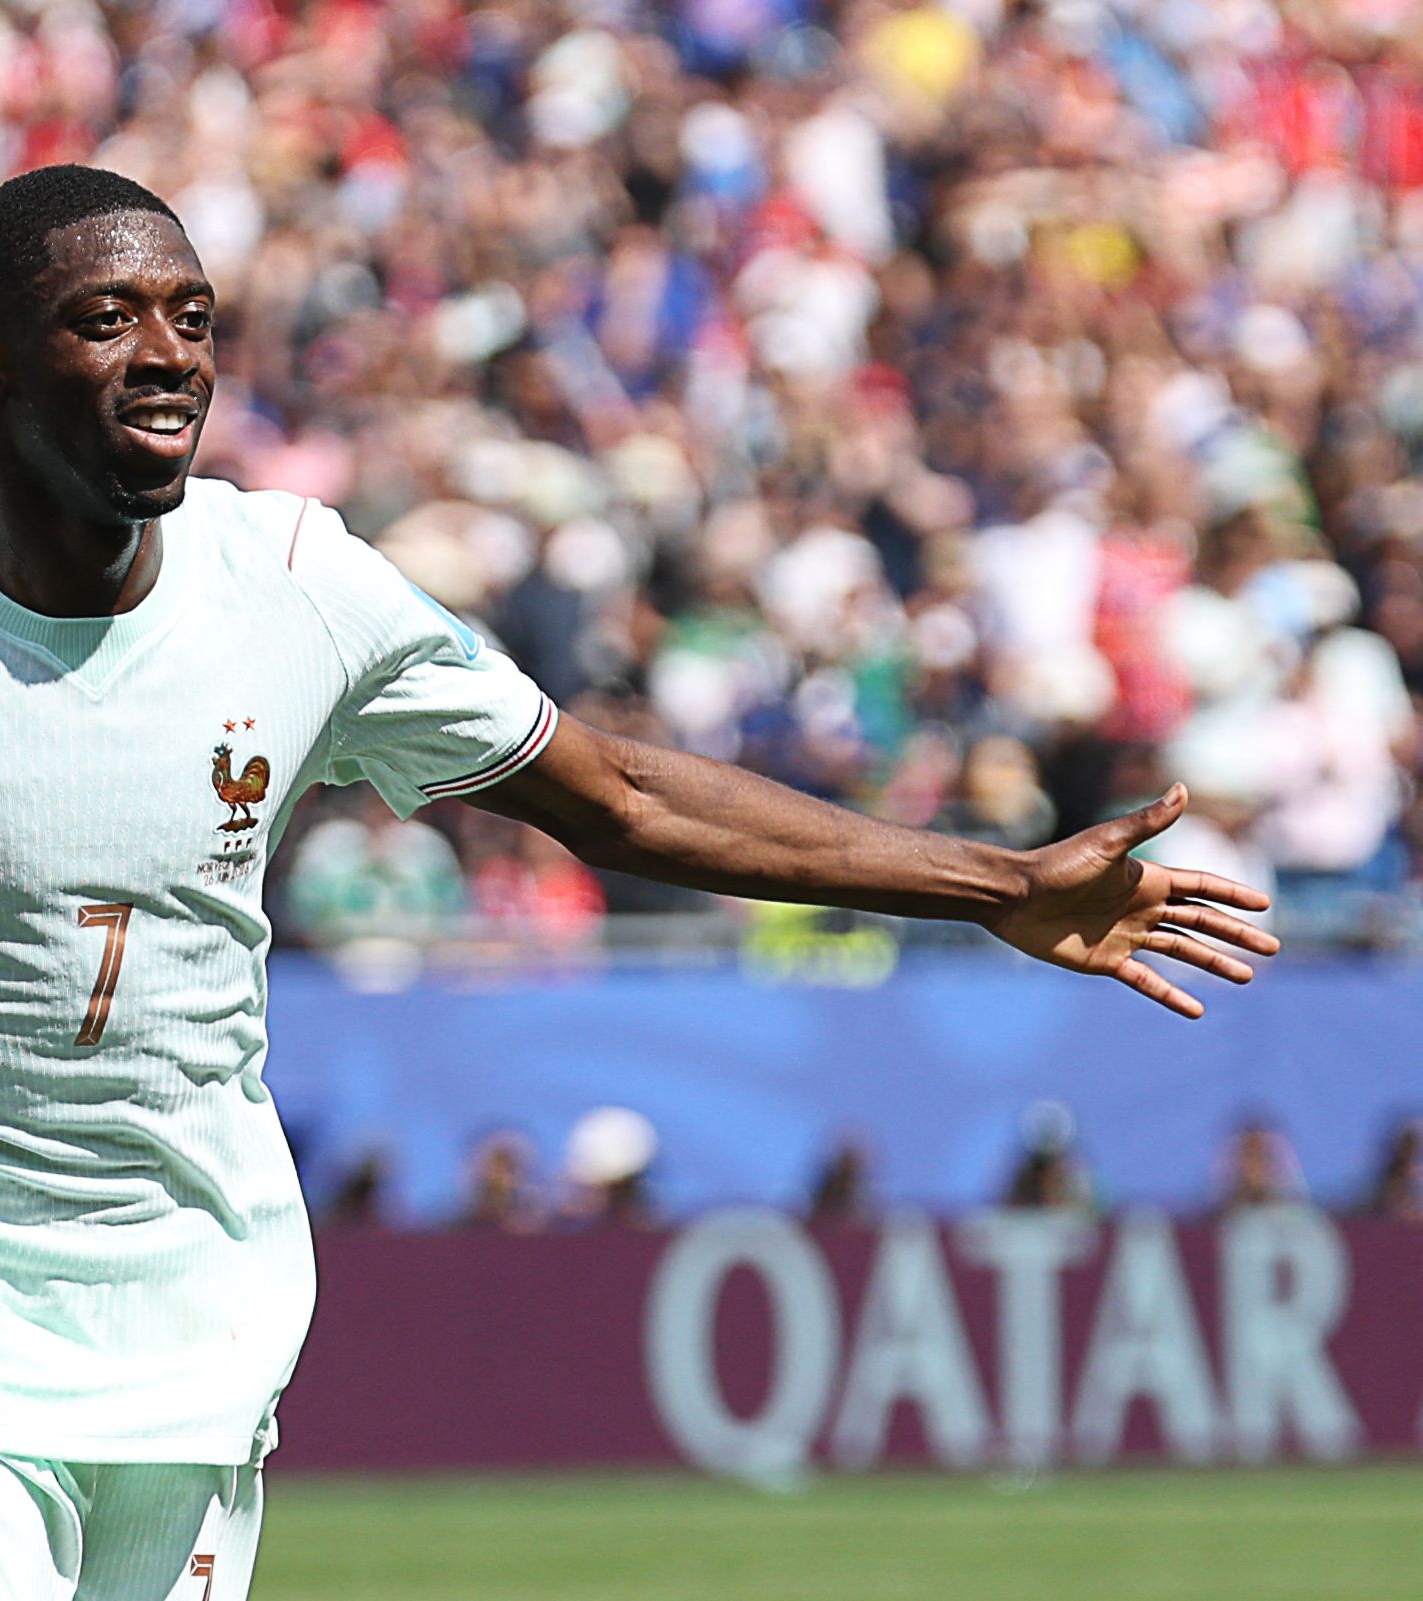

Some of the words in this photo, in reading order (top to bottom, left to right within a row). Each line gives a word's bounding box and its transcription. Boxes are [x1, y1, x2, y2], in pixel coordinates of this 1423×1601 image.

[204, 875, 214, 886] 26
[74, 903, 133, 1047] 7
[639, 1204, 1365, 1488] QATAR
[190, 1553, 215, 1601] 7
